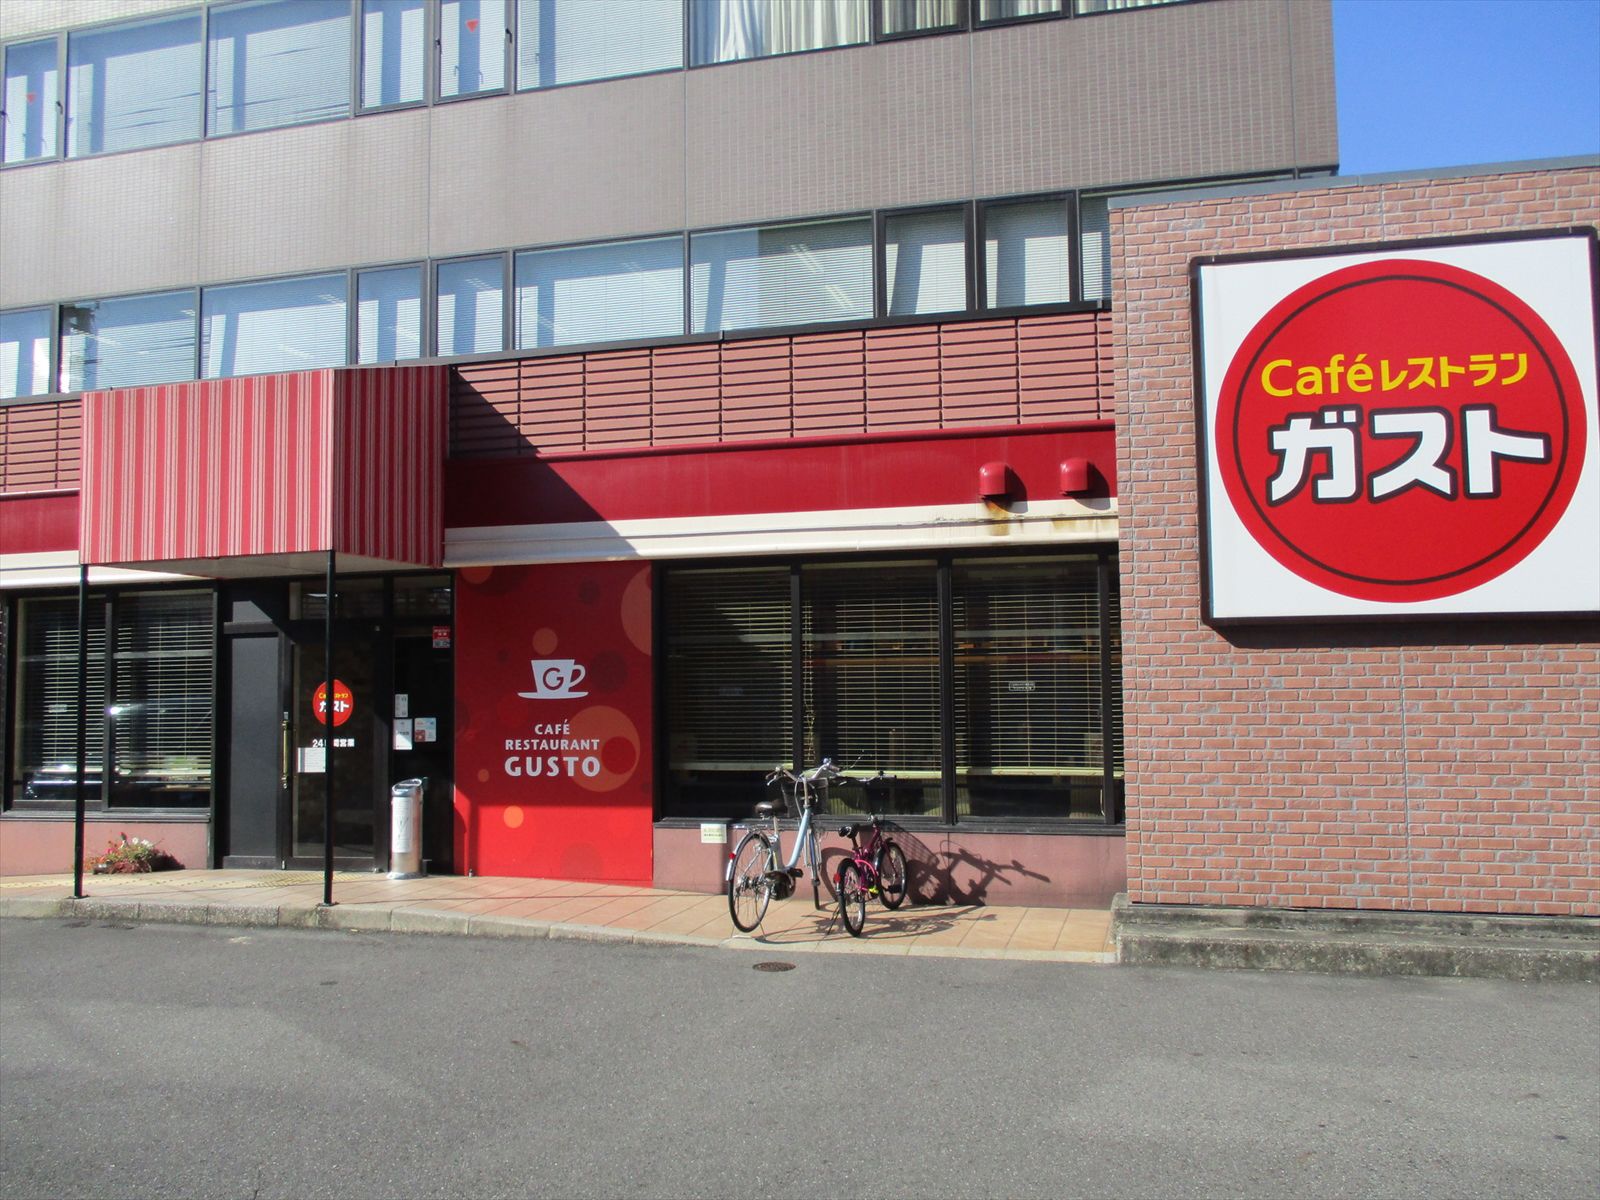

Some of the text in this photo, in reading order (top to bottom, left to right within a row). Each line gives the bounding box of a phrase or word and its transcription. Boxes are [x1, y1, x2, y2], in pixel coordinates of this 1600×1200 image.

[1268, 405, 1550, 505] ガスト
[542, 667, 565, 691] G
[534, 718, 571, 735] CAFÉ
[505, 739, 600, 751] RESTAURANT
[504, 756, 601, 777] GUSTO
